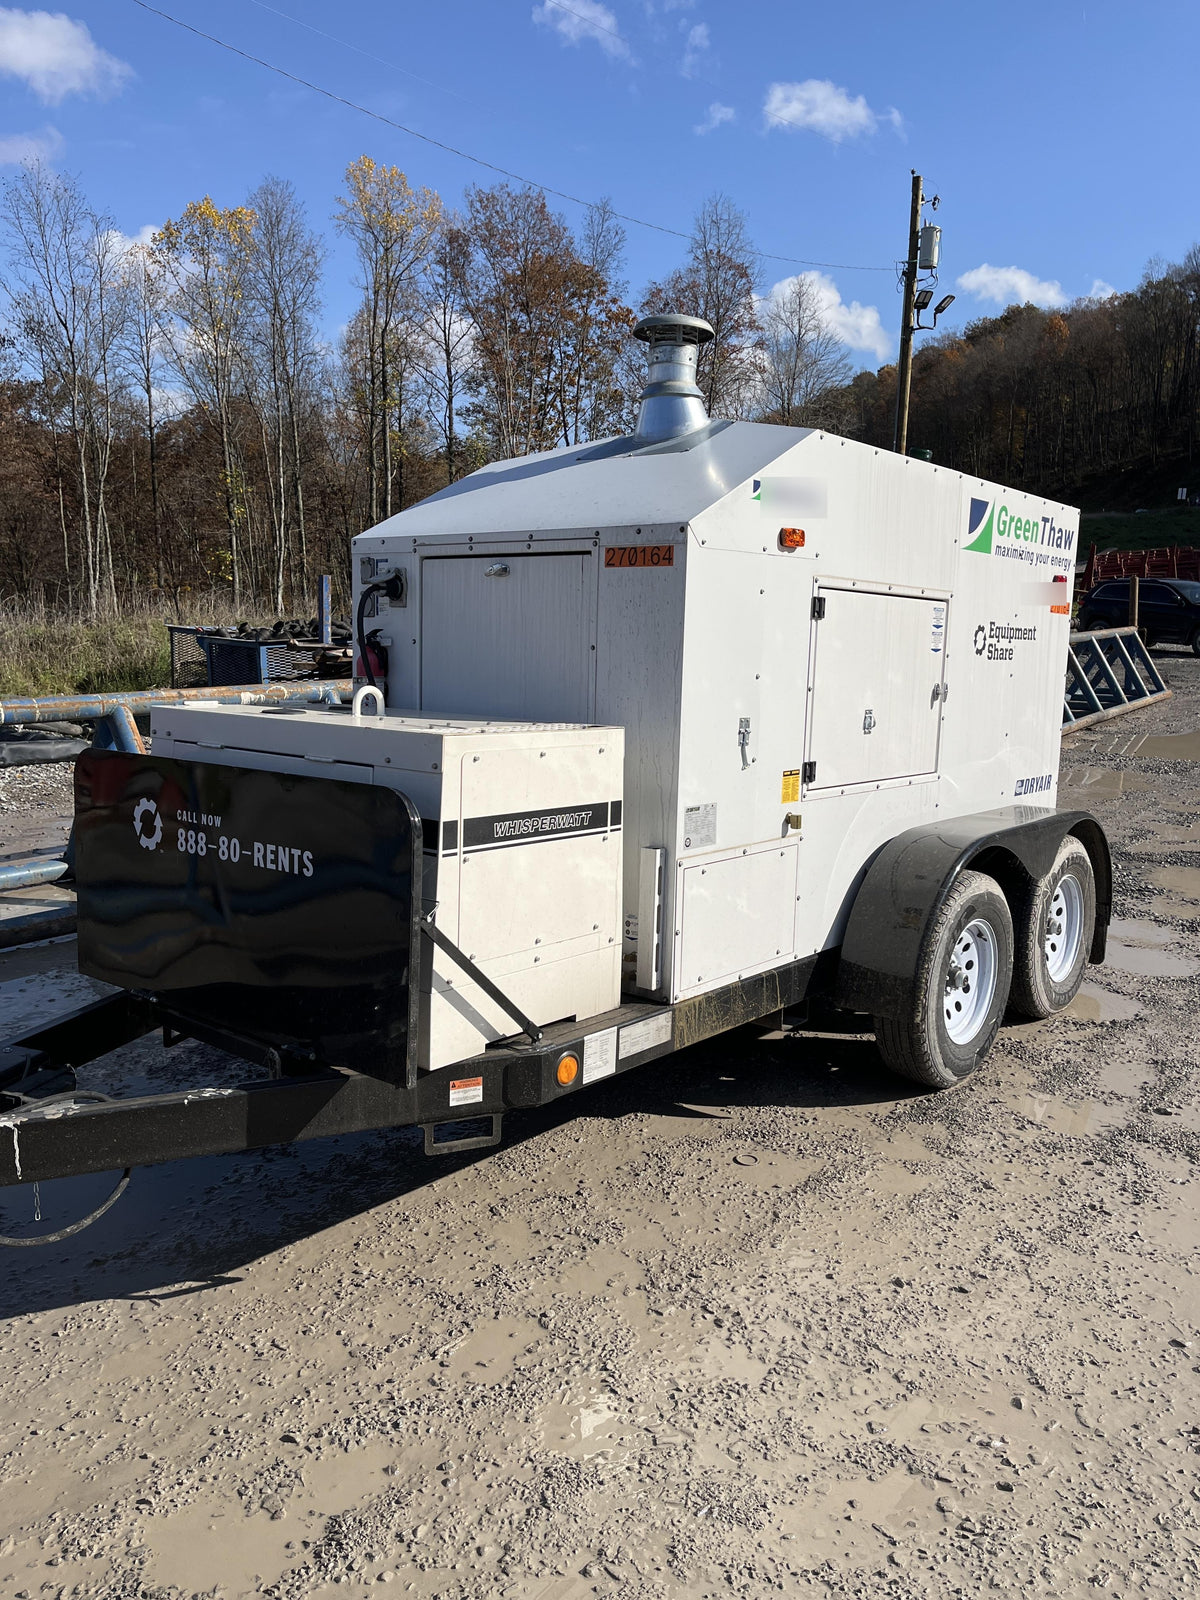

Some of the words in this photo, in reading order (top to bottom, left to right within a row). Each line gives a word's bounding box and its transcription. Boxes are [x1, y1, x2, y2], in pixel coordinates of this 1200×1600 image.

[606, 545, 673, 567] 270164
[994, 543, 1035, 566] maximizing
[1035, 552, 1050, 567] your
[1050, 555, 1072, 572] energy
[988, 621, 1037, 643] Equipment
[987, 643, 1014, 661] Share
[1023, 774, 1053, 795] DRYAIR
[176, 809, 198, 824] CALL
[201, 813, 222, 828] NOW
[493, 811, 593, 838] WHISPERWATT
[177, 828, 314, 877] 888-80-RENTS
